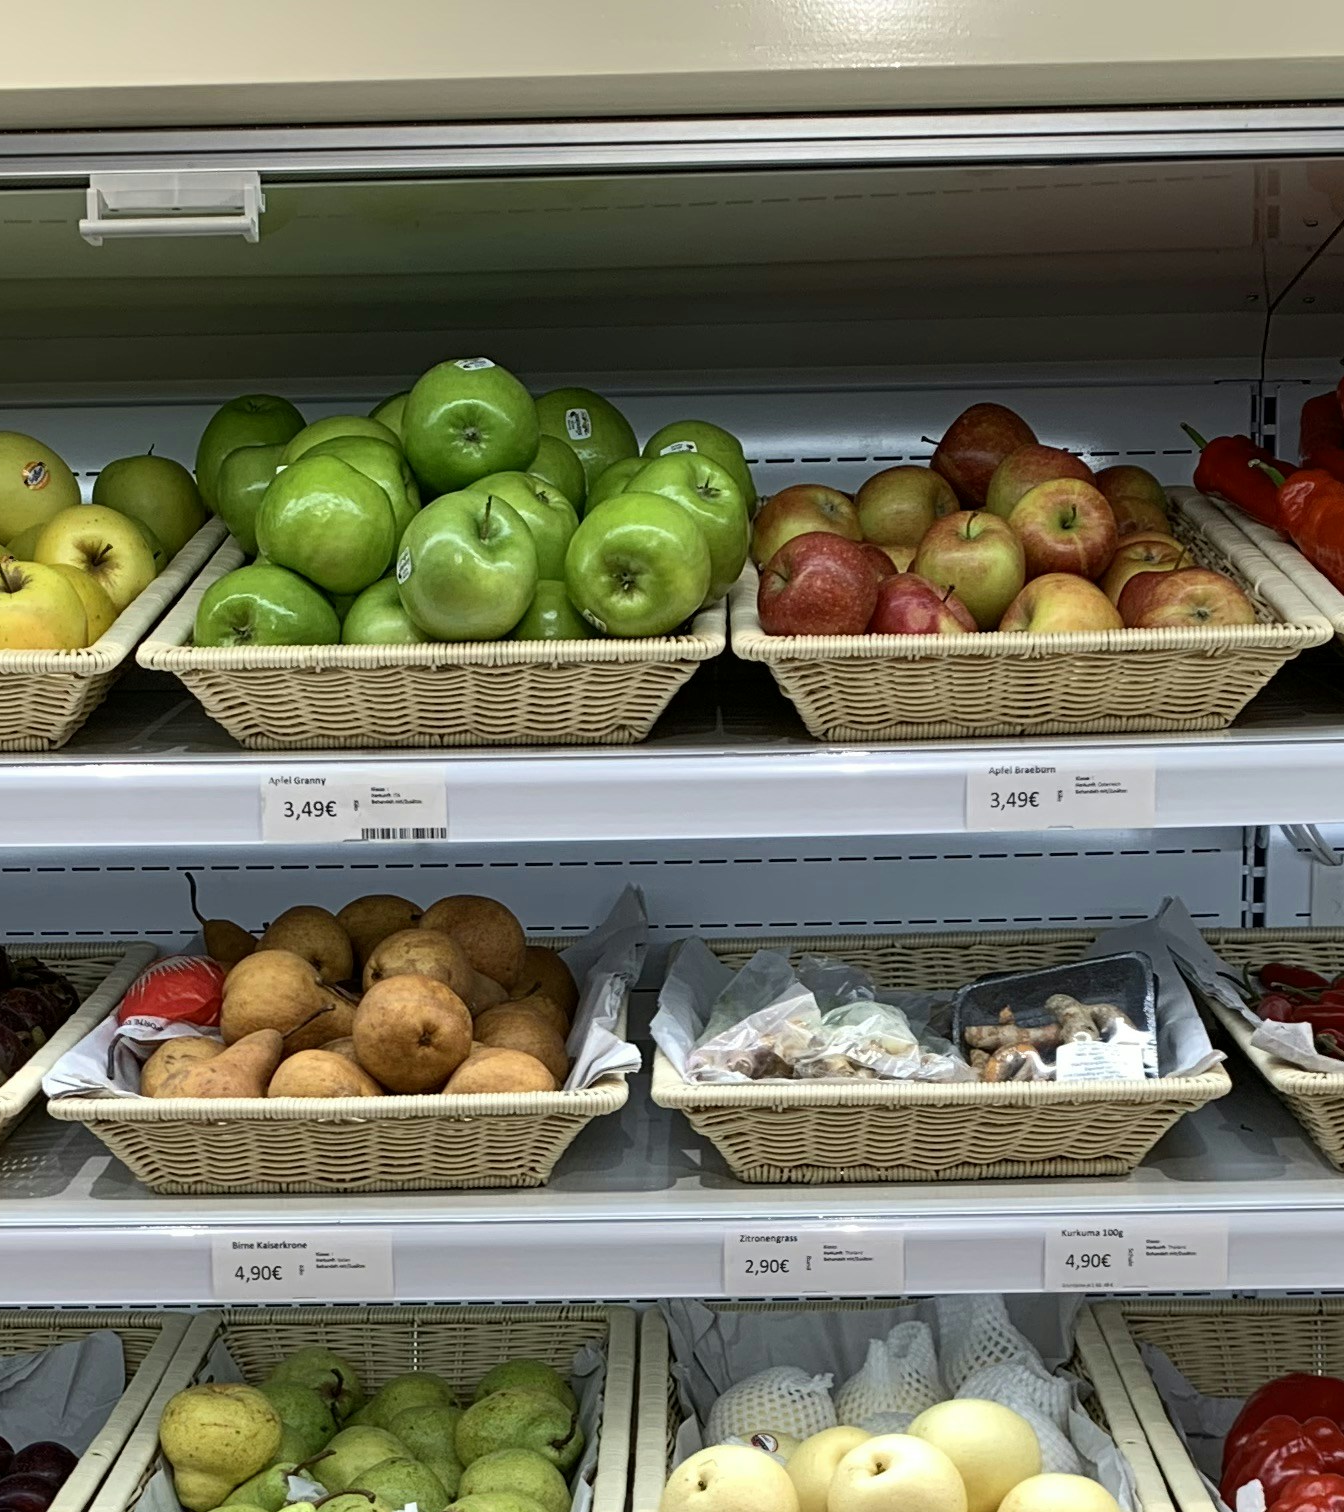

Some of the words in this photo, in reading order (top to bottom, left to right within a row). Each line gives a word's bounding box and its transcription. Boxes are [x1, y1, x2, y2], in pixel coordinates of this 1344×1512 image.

[989, 766, 1012, 776] Apfel
[1015, 766, 1055, 774] Braeburn
[269, 776, 291, 786] Apfel
[294, 777, 326, 786] Granny
[991, 792, 1039, 810] 3,49€
[284, 801, 337, 820] 3,49€
[740, 1235, 797, 1243] Zitronengrass
[1103, 1229, 1123, 1238] 100g
[256, 1241, 307, 1249] Kaiserkrone
[745, 1260, 789, 1275] 2,90€
[1065, 1254, 1111, 1270] 4,90€
[235, 1266, 282, 1282] 4,90€
